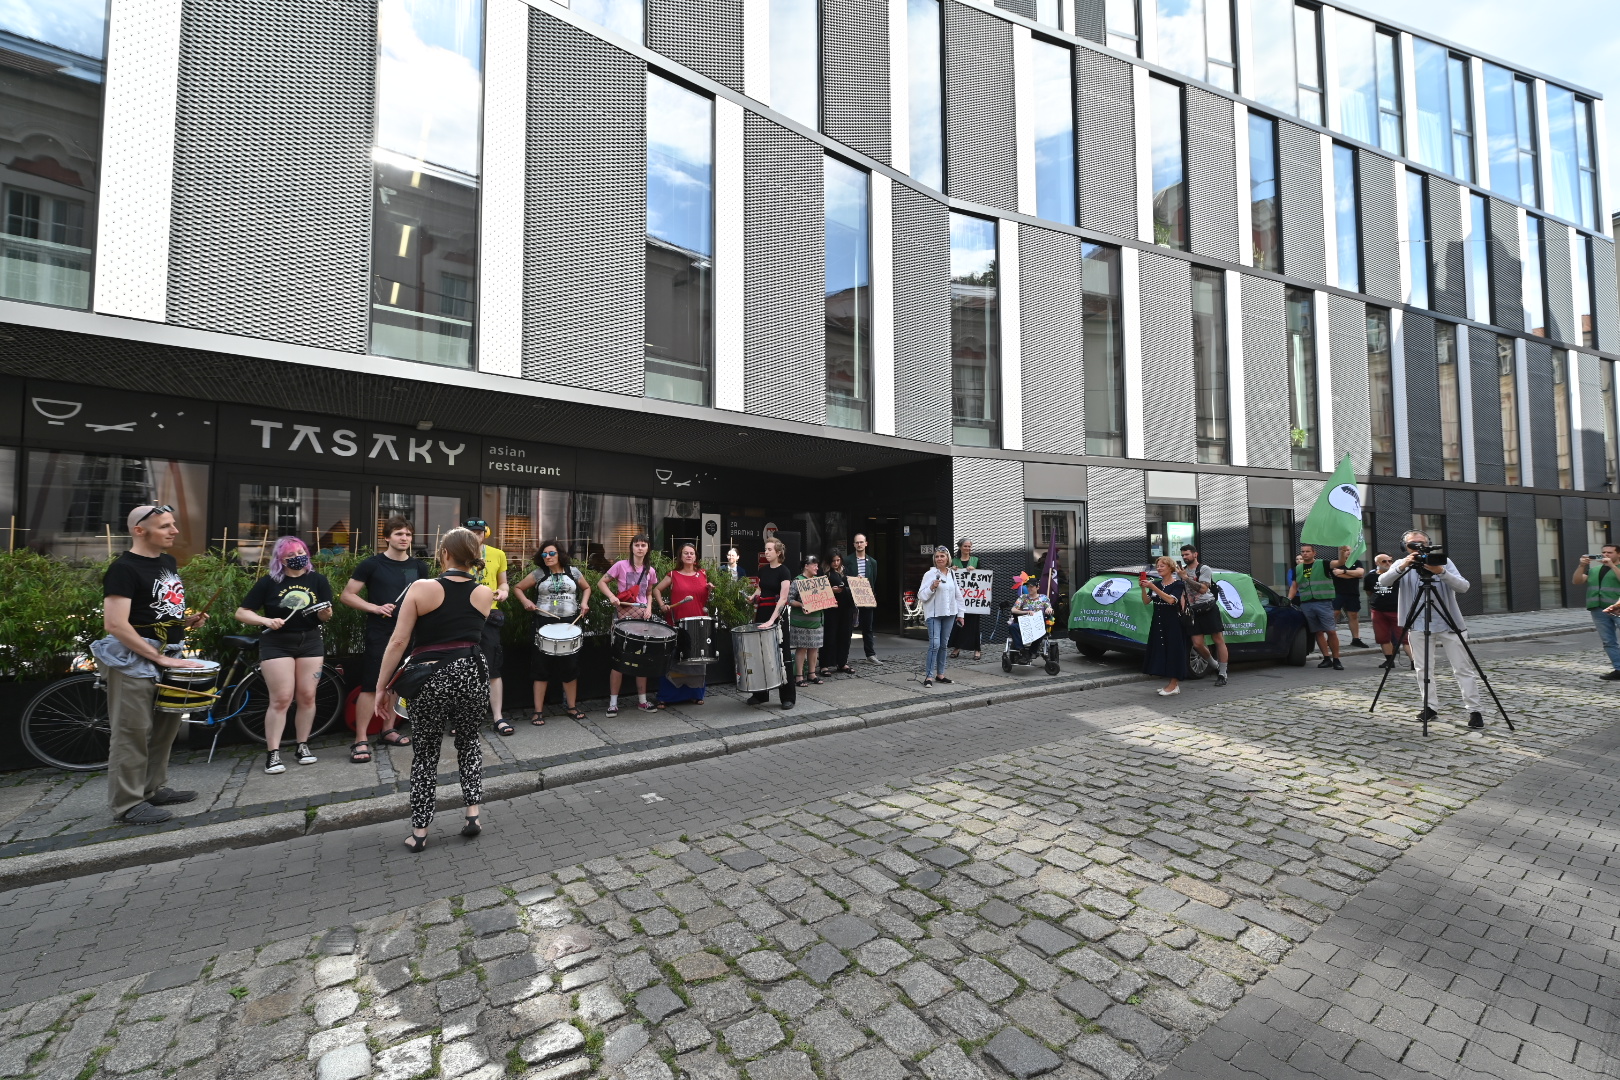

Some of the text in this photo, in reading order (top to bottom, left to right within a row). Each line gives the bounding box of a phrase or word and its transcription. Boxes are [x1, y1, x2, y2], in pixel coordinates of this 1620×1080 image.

[250, 419, 466, 466] TASAKY
[488, 445, 526, 459] asian
[488, 460, 561, 476] restaurant
[955, 571, 992, 583] ESTEŚMY
[964, 598, 991, 608] OPERA
